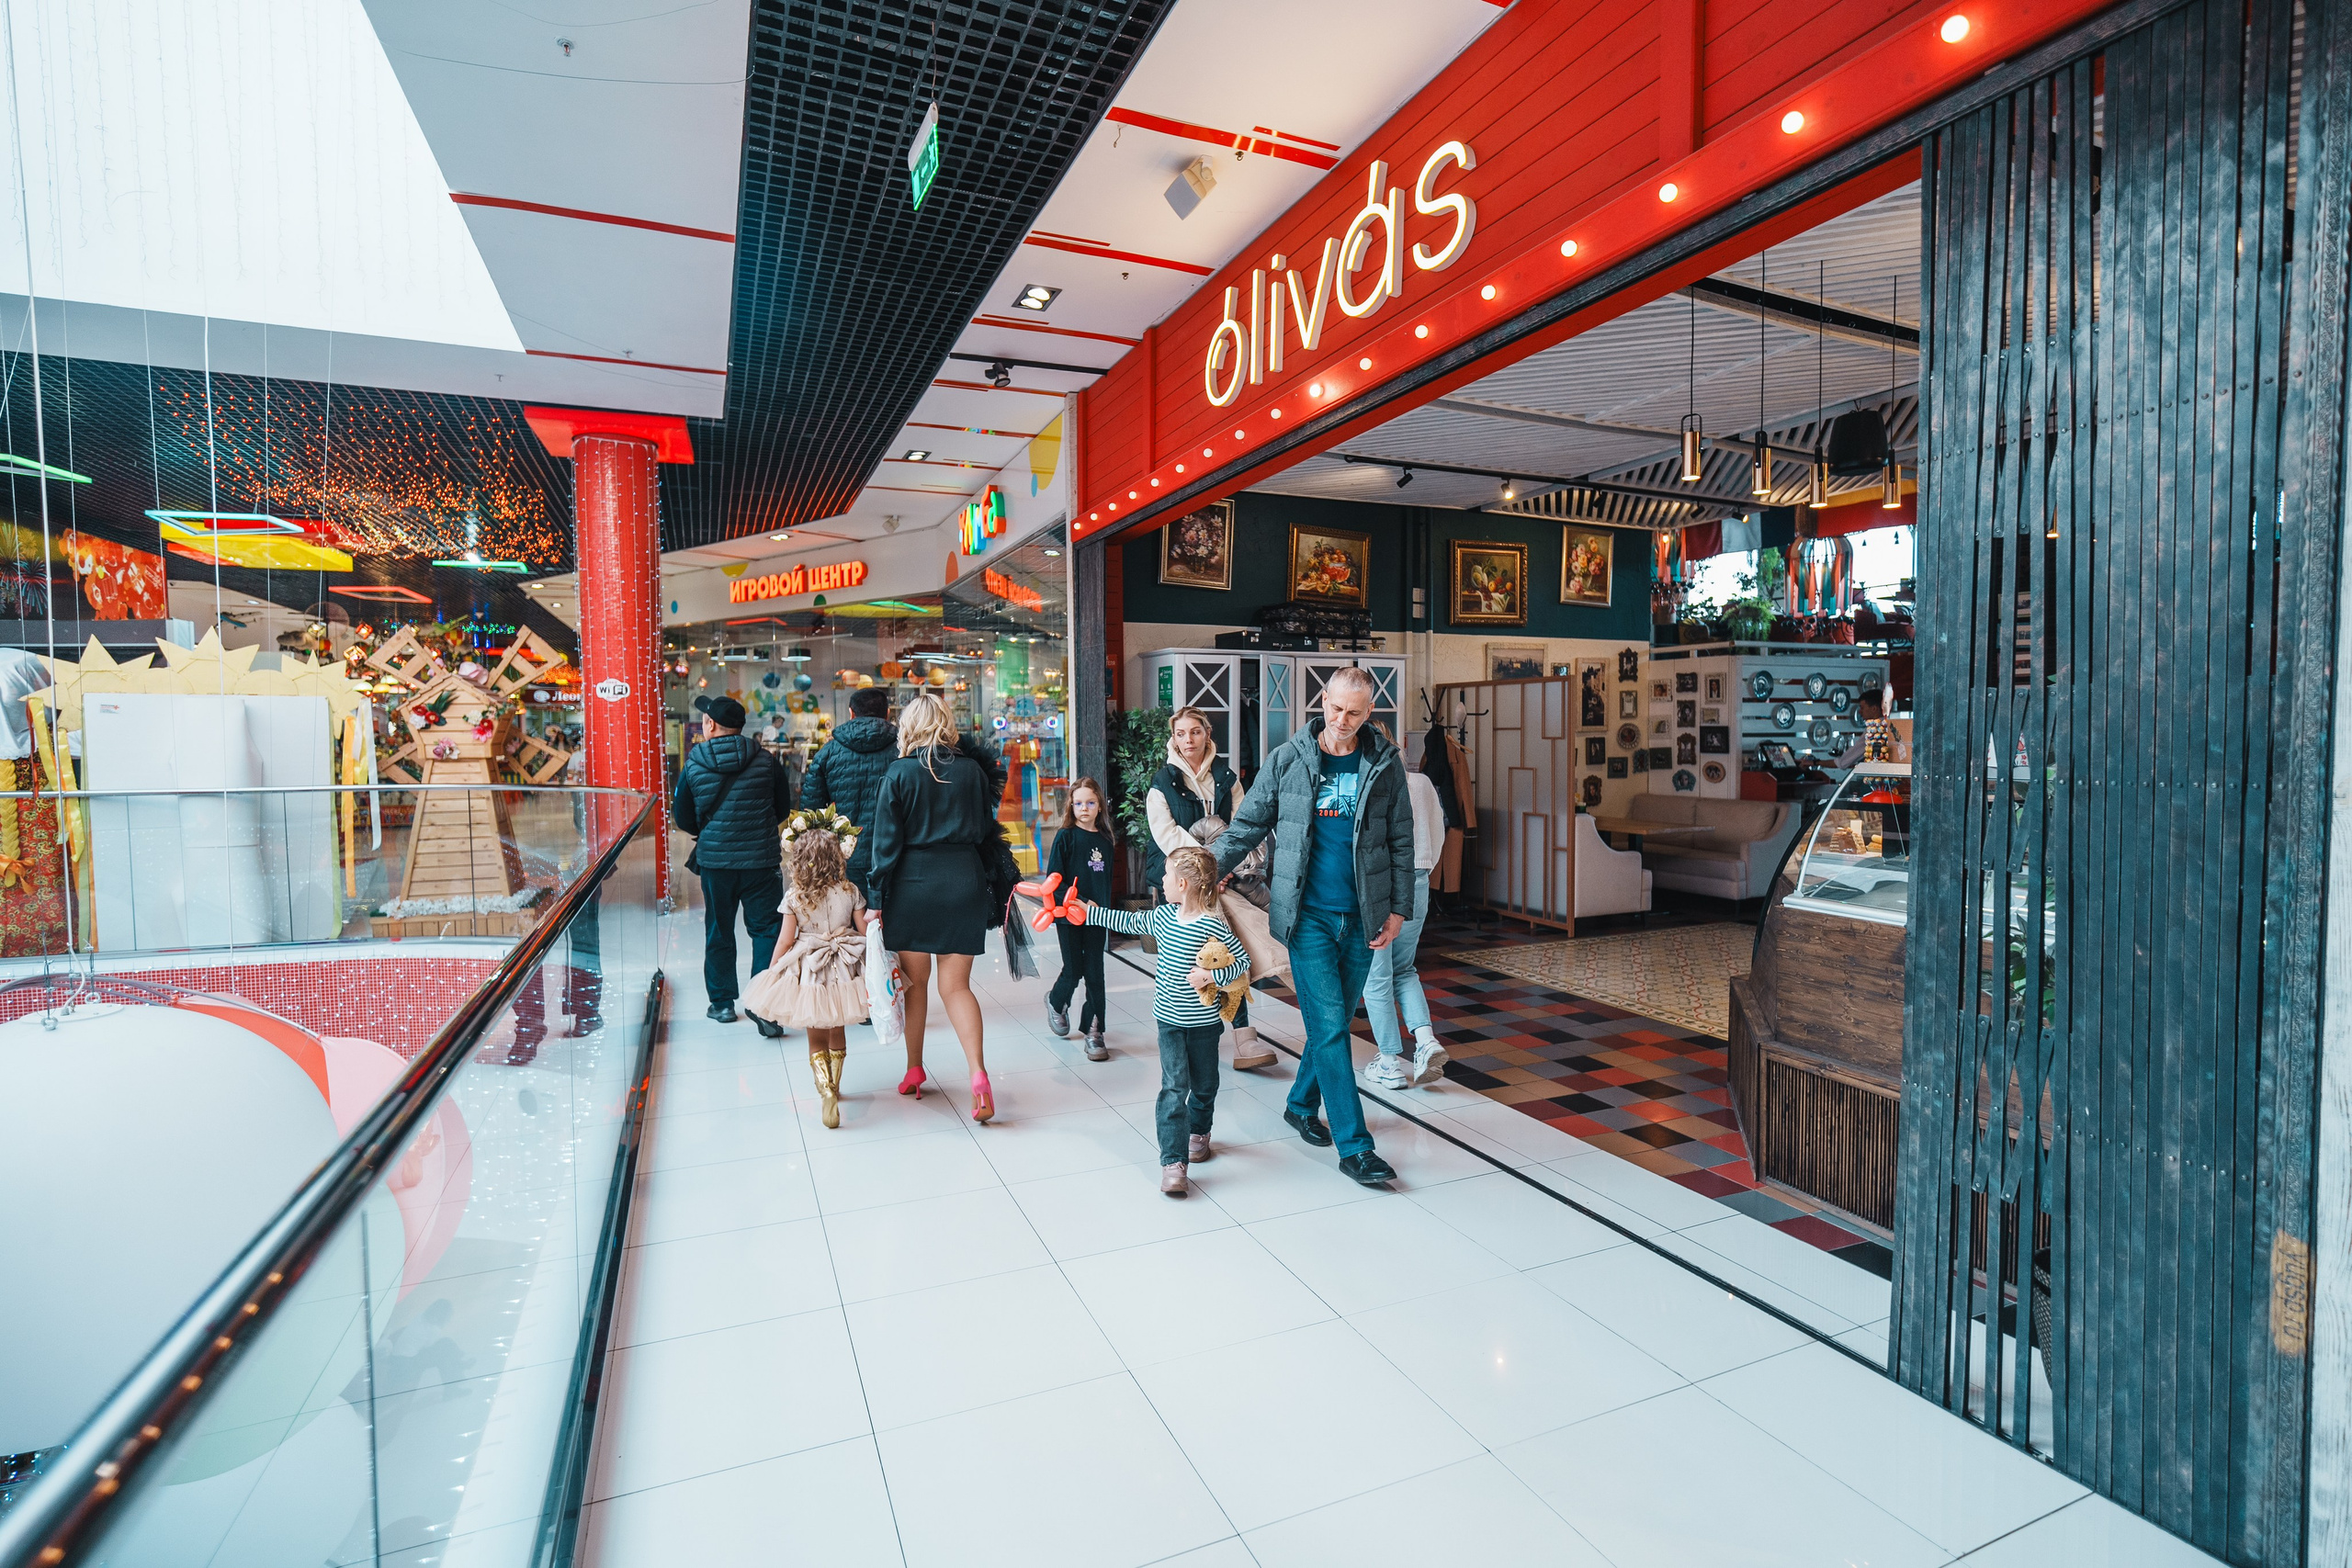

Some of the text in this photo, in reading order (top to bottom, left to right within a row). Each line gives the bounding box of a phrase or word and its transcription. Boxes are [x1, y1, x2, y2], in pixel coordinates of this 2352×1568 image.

[729, 560, 868, 604] ИГРОВОЙ ЦЕНТР
[1318, 809, 1339, 818] 2008
